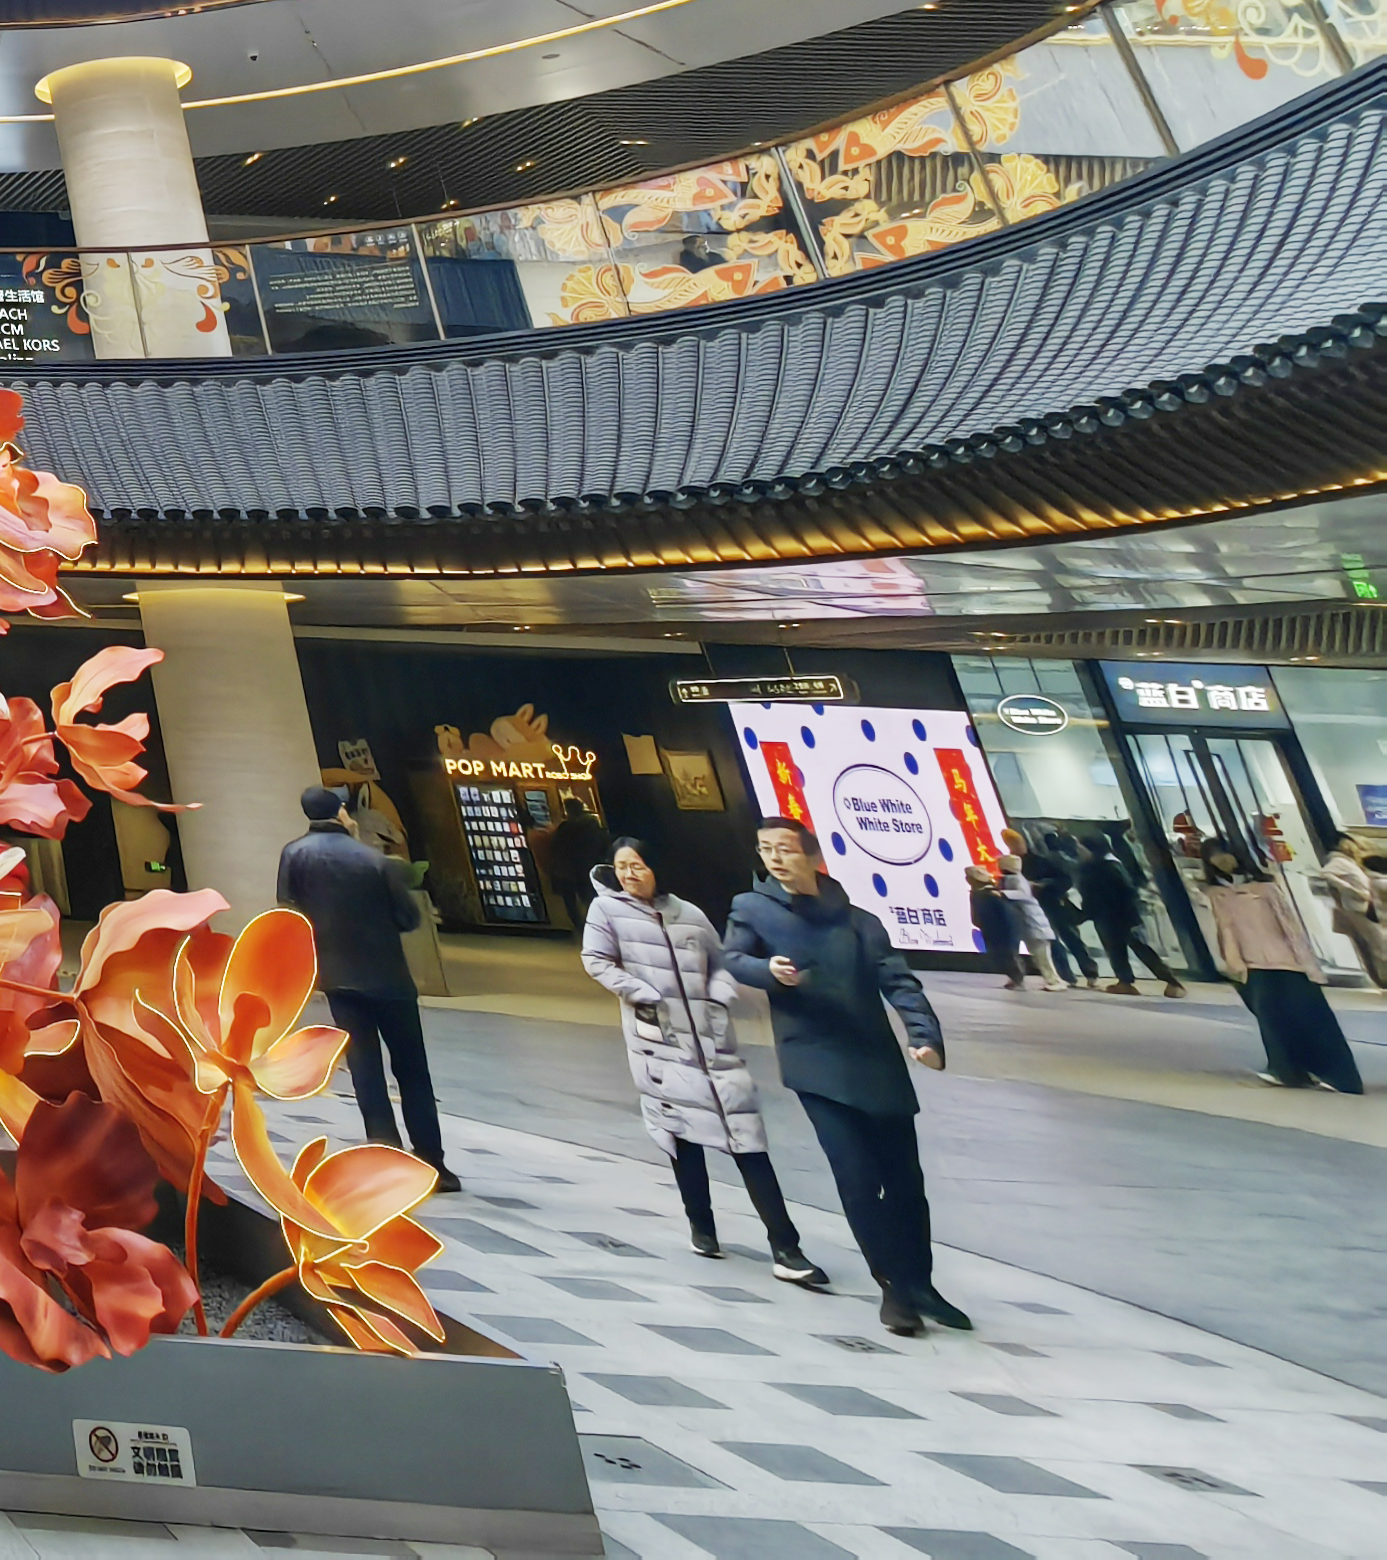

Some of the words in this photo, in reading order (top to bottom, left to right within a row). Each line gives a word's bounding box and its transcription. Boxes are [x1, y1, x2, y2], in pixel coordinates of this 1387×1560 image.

[23, 339, 61, 352] KORS
[445, 758, 485, 776] POP
[490, 760, 546, 779] MART
[852, 796, 878, 813] Blue
[878, 798, 913, 815] White
[856, 816, 890, 833] White
[892, 818, 924, 834] Store
